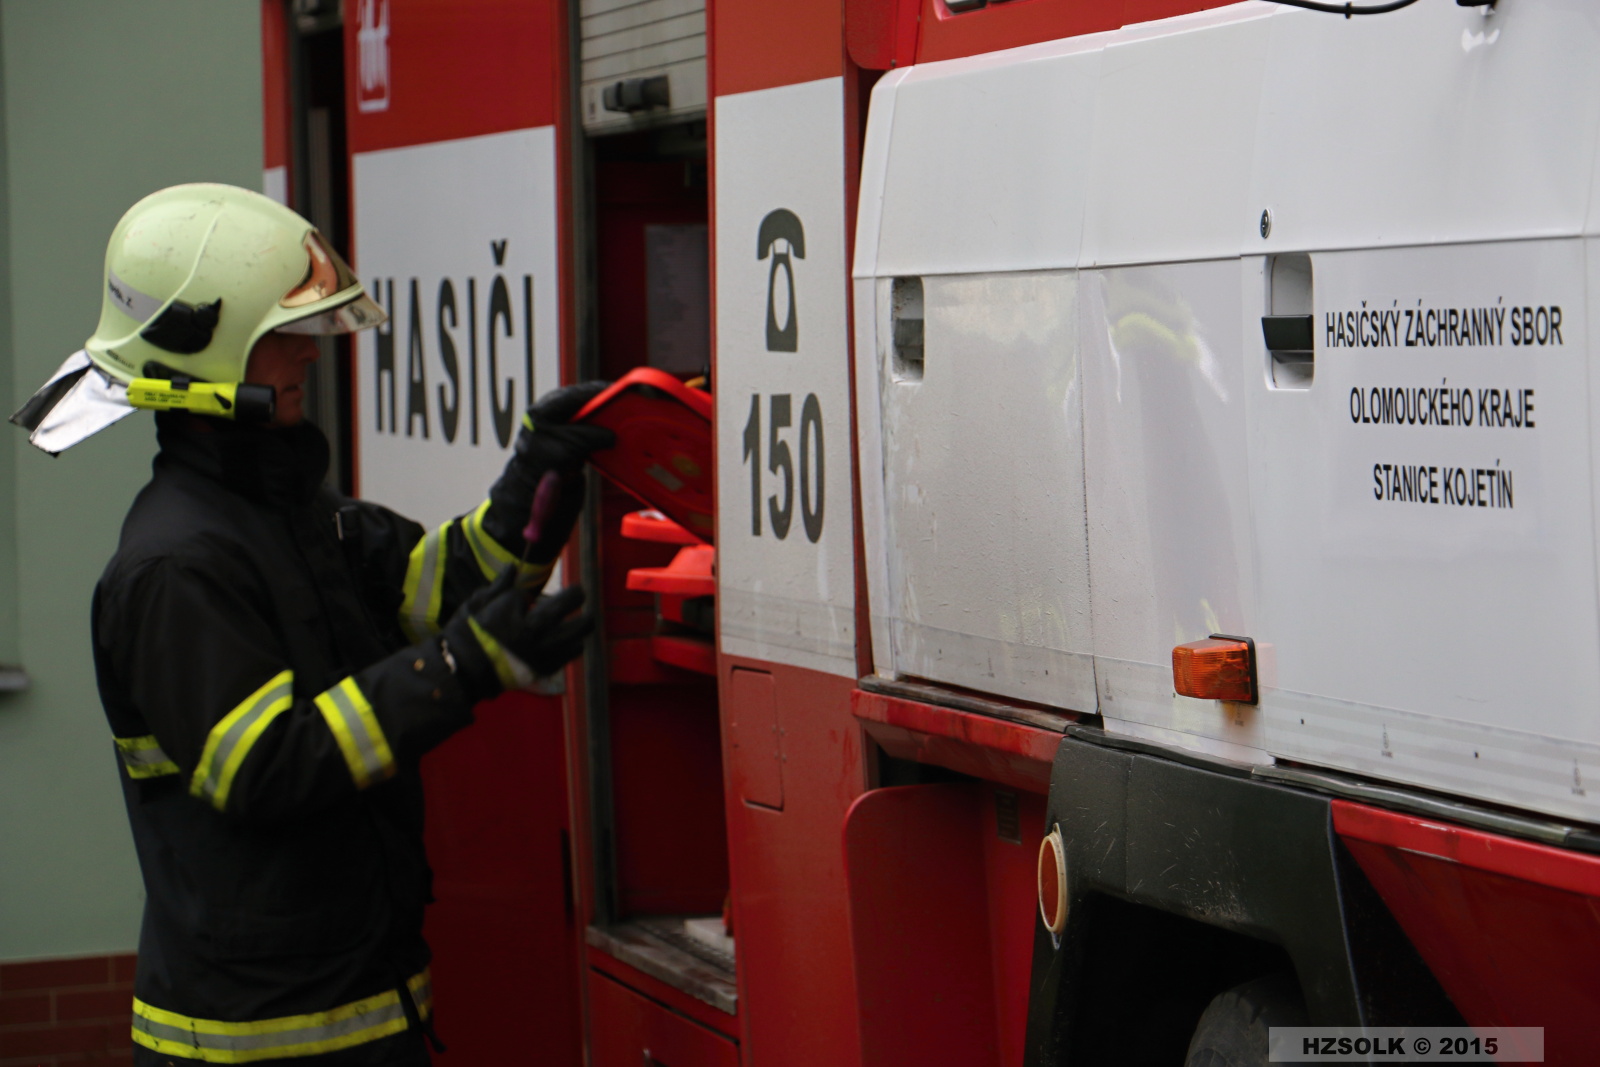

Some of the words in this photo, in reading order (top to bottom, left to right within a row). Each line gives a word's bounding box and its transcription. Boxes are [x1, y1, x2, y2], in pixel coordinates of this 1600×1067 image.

[373, 239, 533, 449] HASIČI
[1326, 300, 1401, 347] HASIČSKÝ
[1405, 296, 1506, 347] ZÁCHRANNÝ
[1511, 305, 1563, 346] SBOR
[1350, 377, 1474, 426] OLOMOUCKÉHO
[1478, 388, 1536, 428] KRAJE
[743, 392, 825, 543] 150
[1373, 463, 1440, 504] STANICE
[1443, 459, 1514, 509] KOJETÍN
